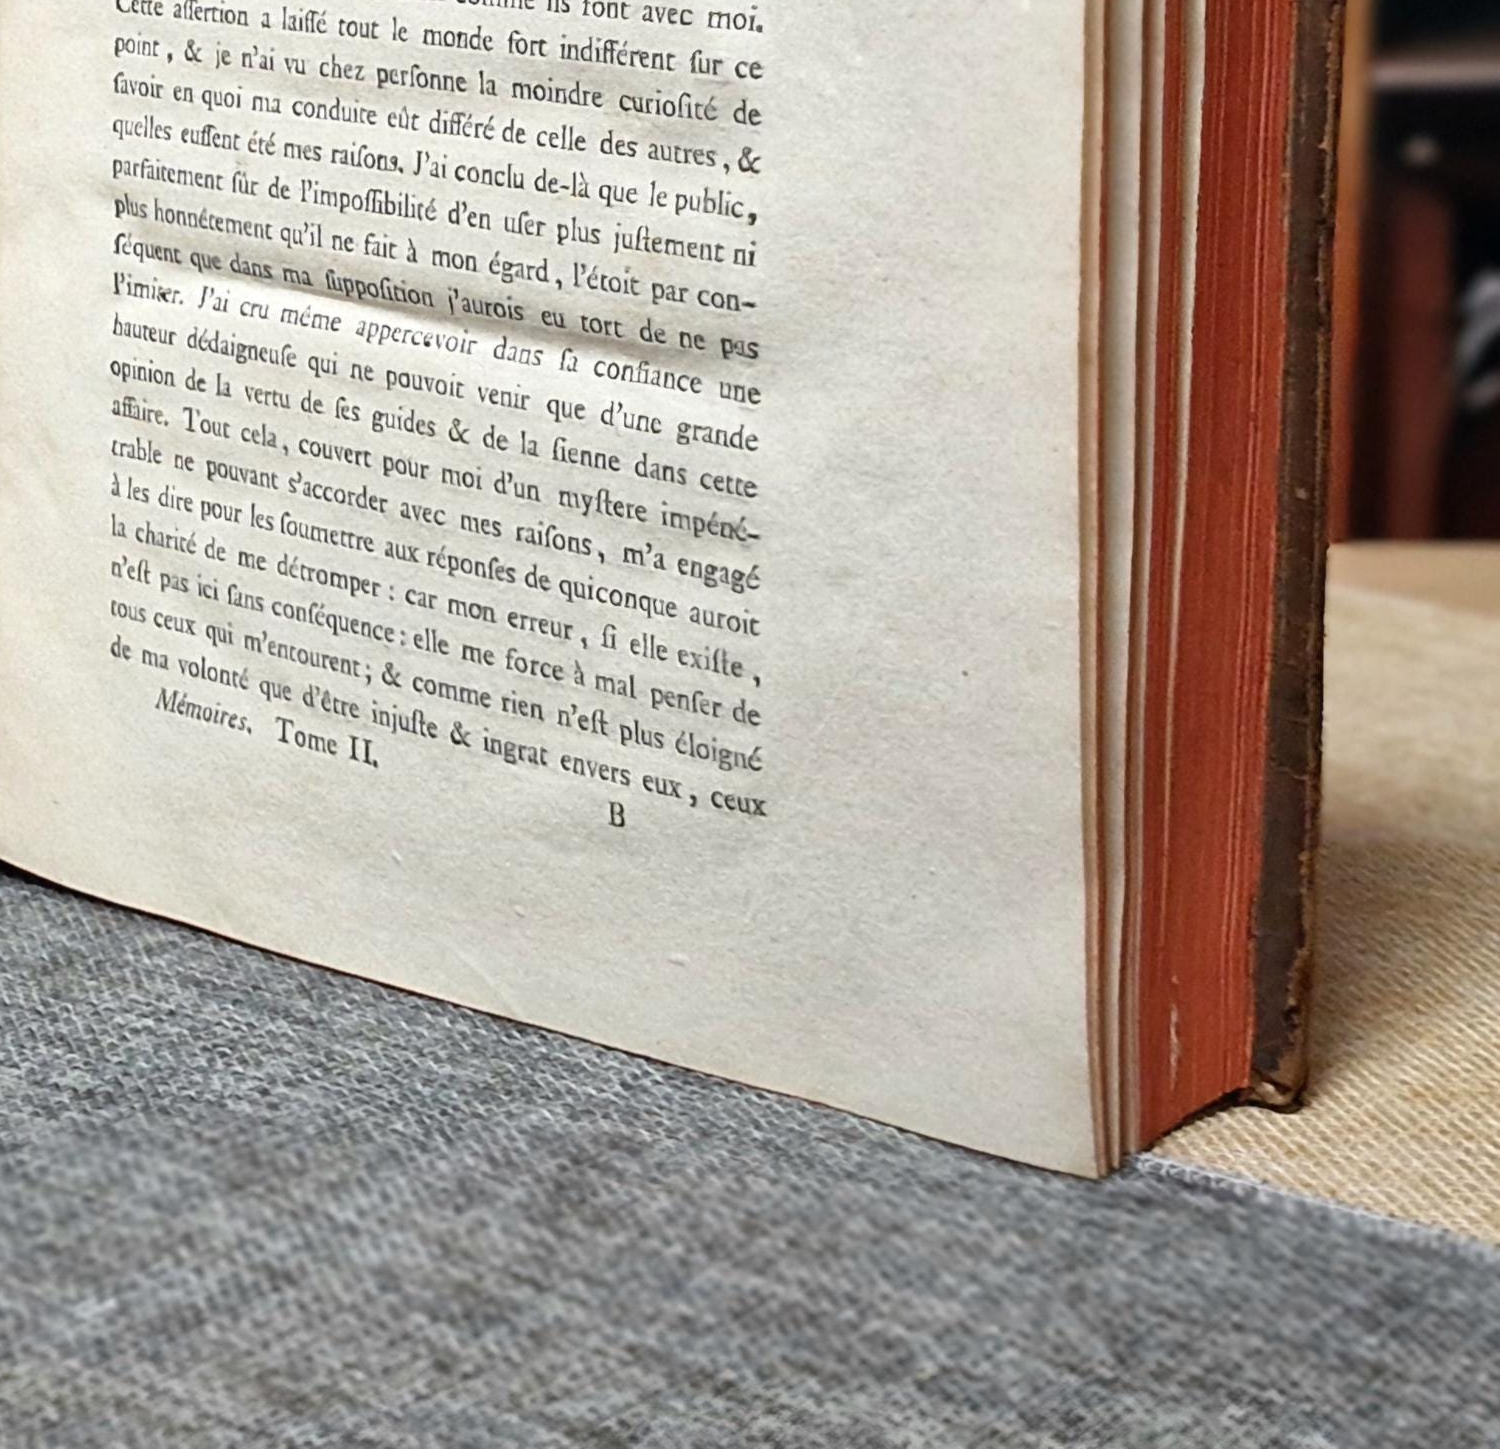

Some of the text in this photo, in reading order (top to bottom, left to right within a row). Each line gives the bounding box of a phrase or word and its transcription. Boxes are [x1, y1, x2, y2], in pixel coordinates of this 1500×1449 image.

[641, 4, 694, 26] avec
[707, 4, 764, 34] moi.
[172, 86, 194, 104] en
[201, 89, 241, 112] quoi
[251, 95, 282, 114] ma
[291, 96, 377, 126] conduite
[387, 105, 420, 132] eût
[428, 108, 495, 141] différé
[501, 117, 527, 145] de
[536, 124, 587, 152] celle
[599, 129, 639, 158] des
[737, 146, 762, 175] &
[112, 311, 177, 346] hauteur
[307, 355, 338, 379] qui
[349, 363, 374, 382] ne
[386, 369, 465, 399] pouvoit
[477, 385, 531, 411] venir
[546, 399, 586, 423] que
[676, 421, 759, 452] grande
[110, 634, 131, 661] de
[141, 649, 169, 671] ma
[178, 655, 249, 691] volonté
[258, 680, 292, 702] que
[449, 721, 472, 748] &
[483, 727, 548, 767] ingrat
[560, 754, 631, 787] envers
[710, 790, 768, 817] ceux
[154, 687, 379, 769] Mémoires. Tome II.
[607, 801, 627, 829] B
